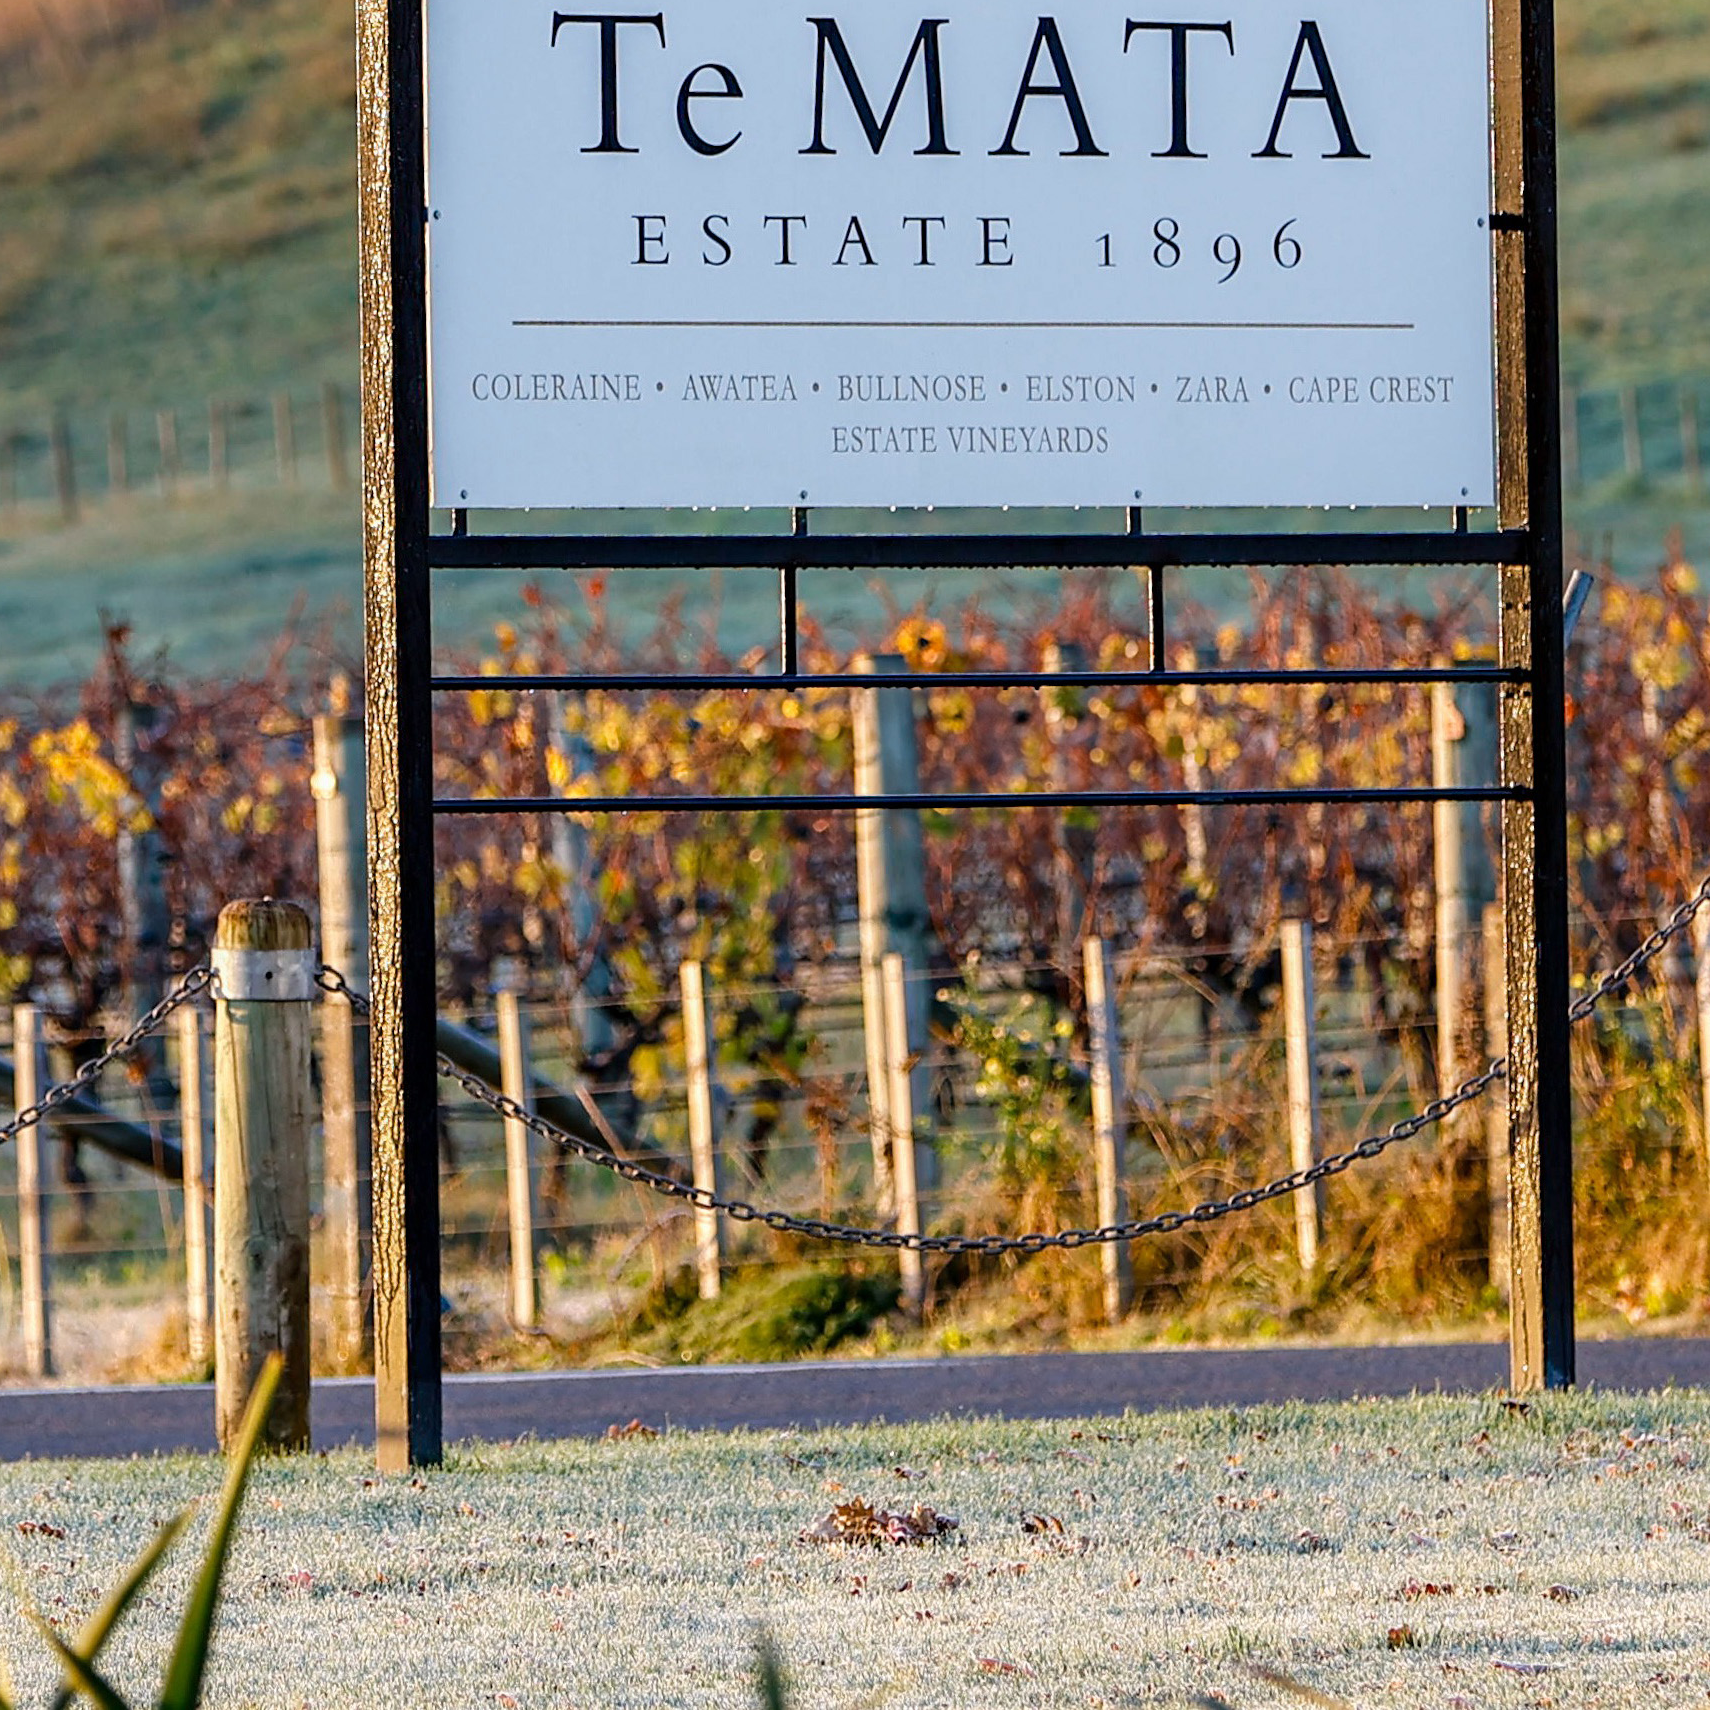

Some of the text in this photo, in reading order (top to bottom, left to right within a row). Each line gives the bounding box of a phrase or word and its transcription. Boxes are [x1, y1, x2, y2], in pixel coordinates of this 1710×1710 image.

[550, 10, 1372, 160] Te MATA
[630, 214, 1302, 285] ESTATE 1896
[472, 373, 1454, 404] COLERAINE AWATEA BULLNOSE ELSTON ZARA CAPE CREST
[831, 426, 1109, 454] ESTATE VINEYARDS
